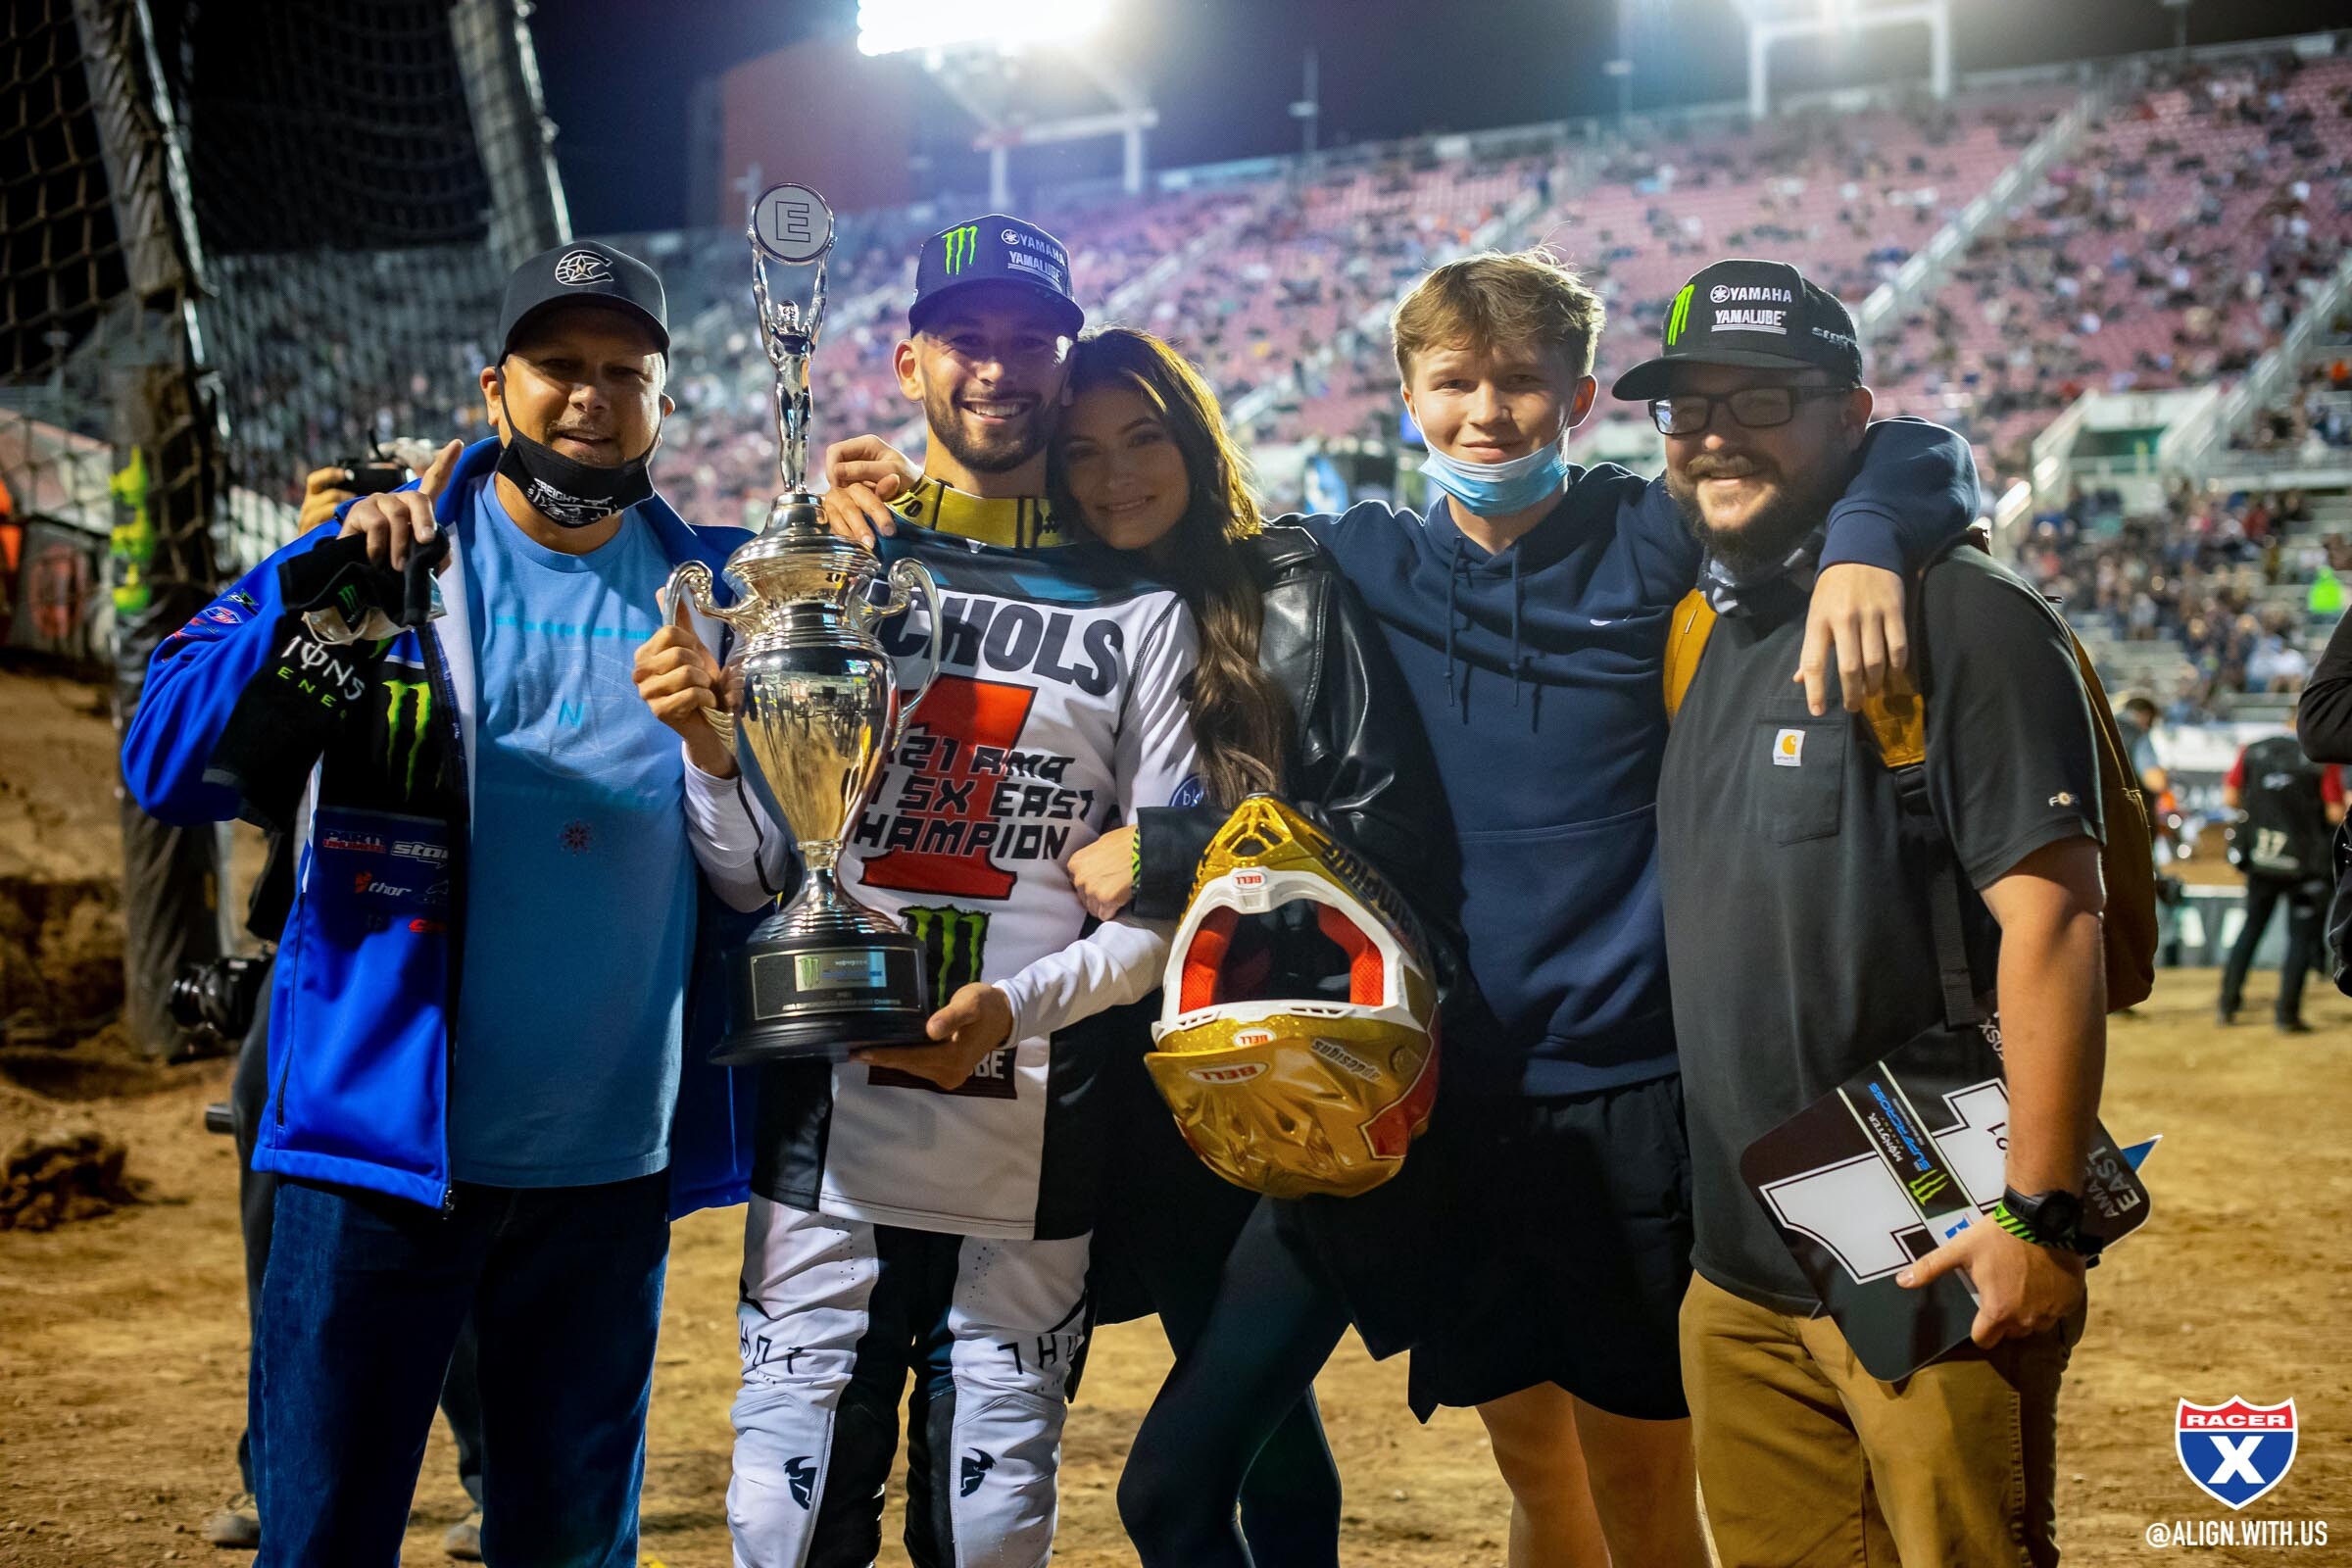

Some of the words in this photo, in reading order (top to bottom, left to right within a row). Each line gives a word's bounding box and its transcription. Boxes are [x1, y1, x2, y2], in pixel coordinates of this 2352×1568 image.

[1020, 233, 1065, 266] YAMAHA
[1008, 251, 1062, 283] YAMALUBE
[1730, 286, 1792, 303] YAMAHA
[1715, 309, 1784, 325] YAMALUBE
[868, 580, 1124, 696] CHOLS
[558, 700, 584, 728] N
[968, 745, 1075, 783] AMA
[989, 782, 1095, 821] EAST
[853, 811, 1071, 860] HAMPION
[368, 882, 413, 897] thor
[1236, 875, 1262, 885] BELL
[1240, 1034, 1269, 1046] BELL
[1200, 1065, 1257, 1081] BELL
[1867, 1111, 1904, 1162] MONSTER
[2085, 1144, 2141, 1212] EAST
[2084, 1179, 2119, 1221] AMA
